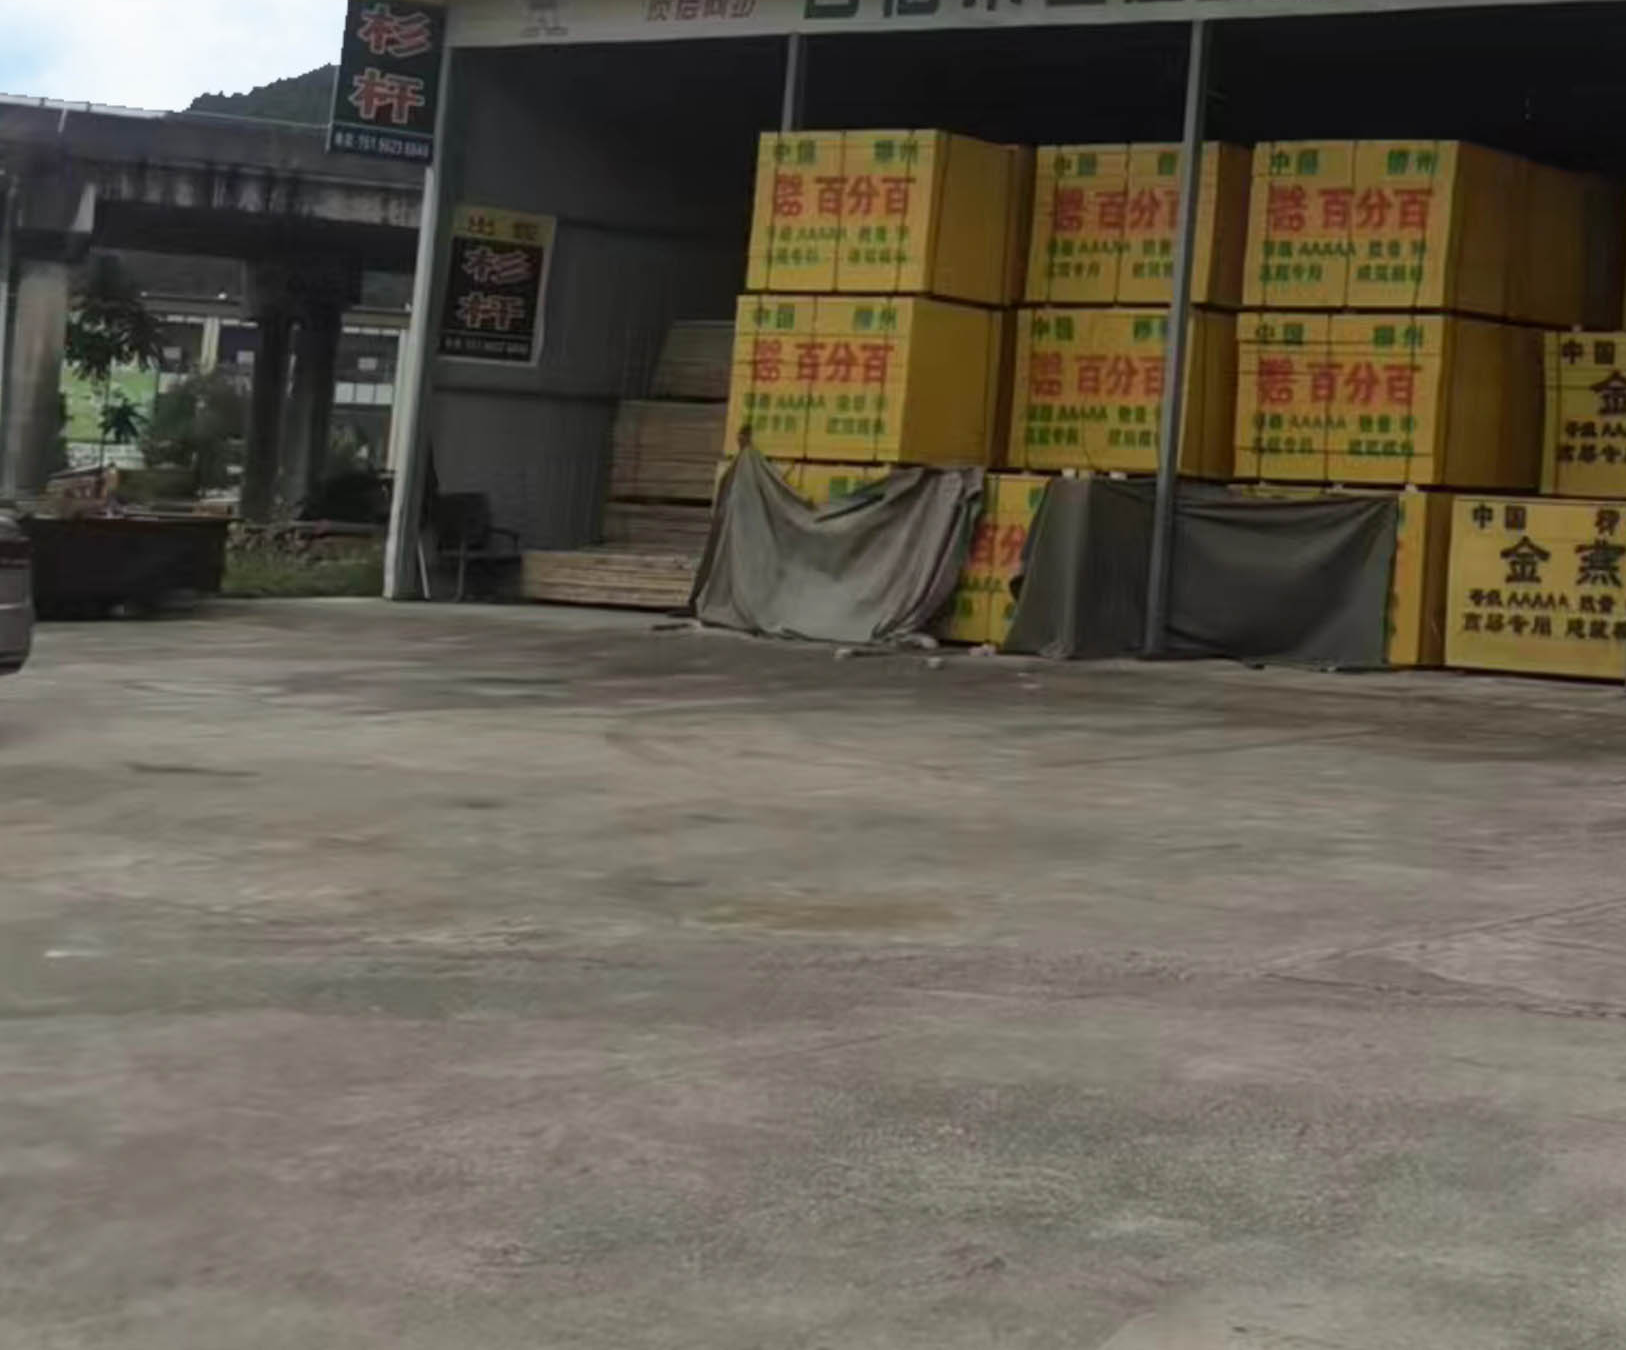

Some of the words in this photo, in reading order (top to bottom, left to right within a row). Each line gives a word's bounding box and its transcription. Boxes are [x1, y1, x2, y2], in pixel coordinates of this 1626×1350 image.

[1317, 186, 1435, 231] 百分百
[1562, 339, 1617, 367] 中国
[1471, 504, 1527, 531] 中国
